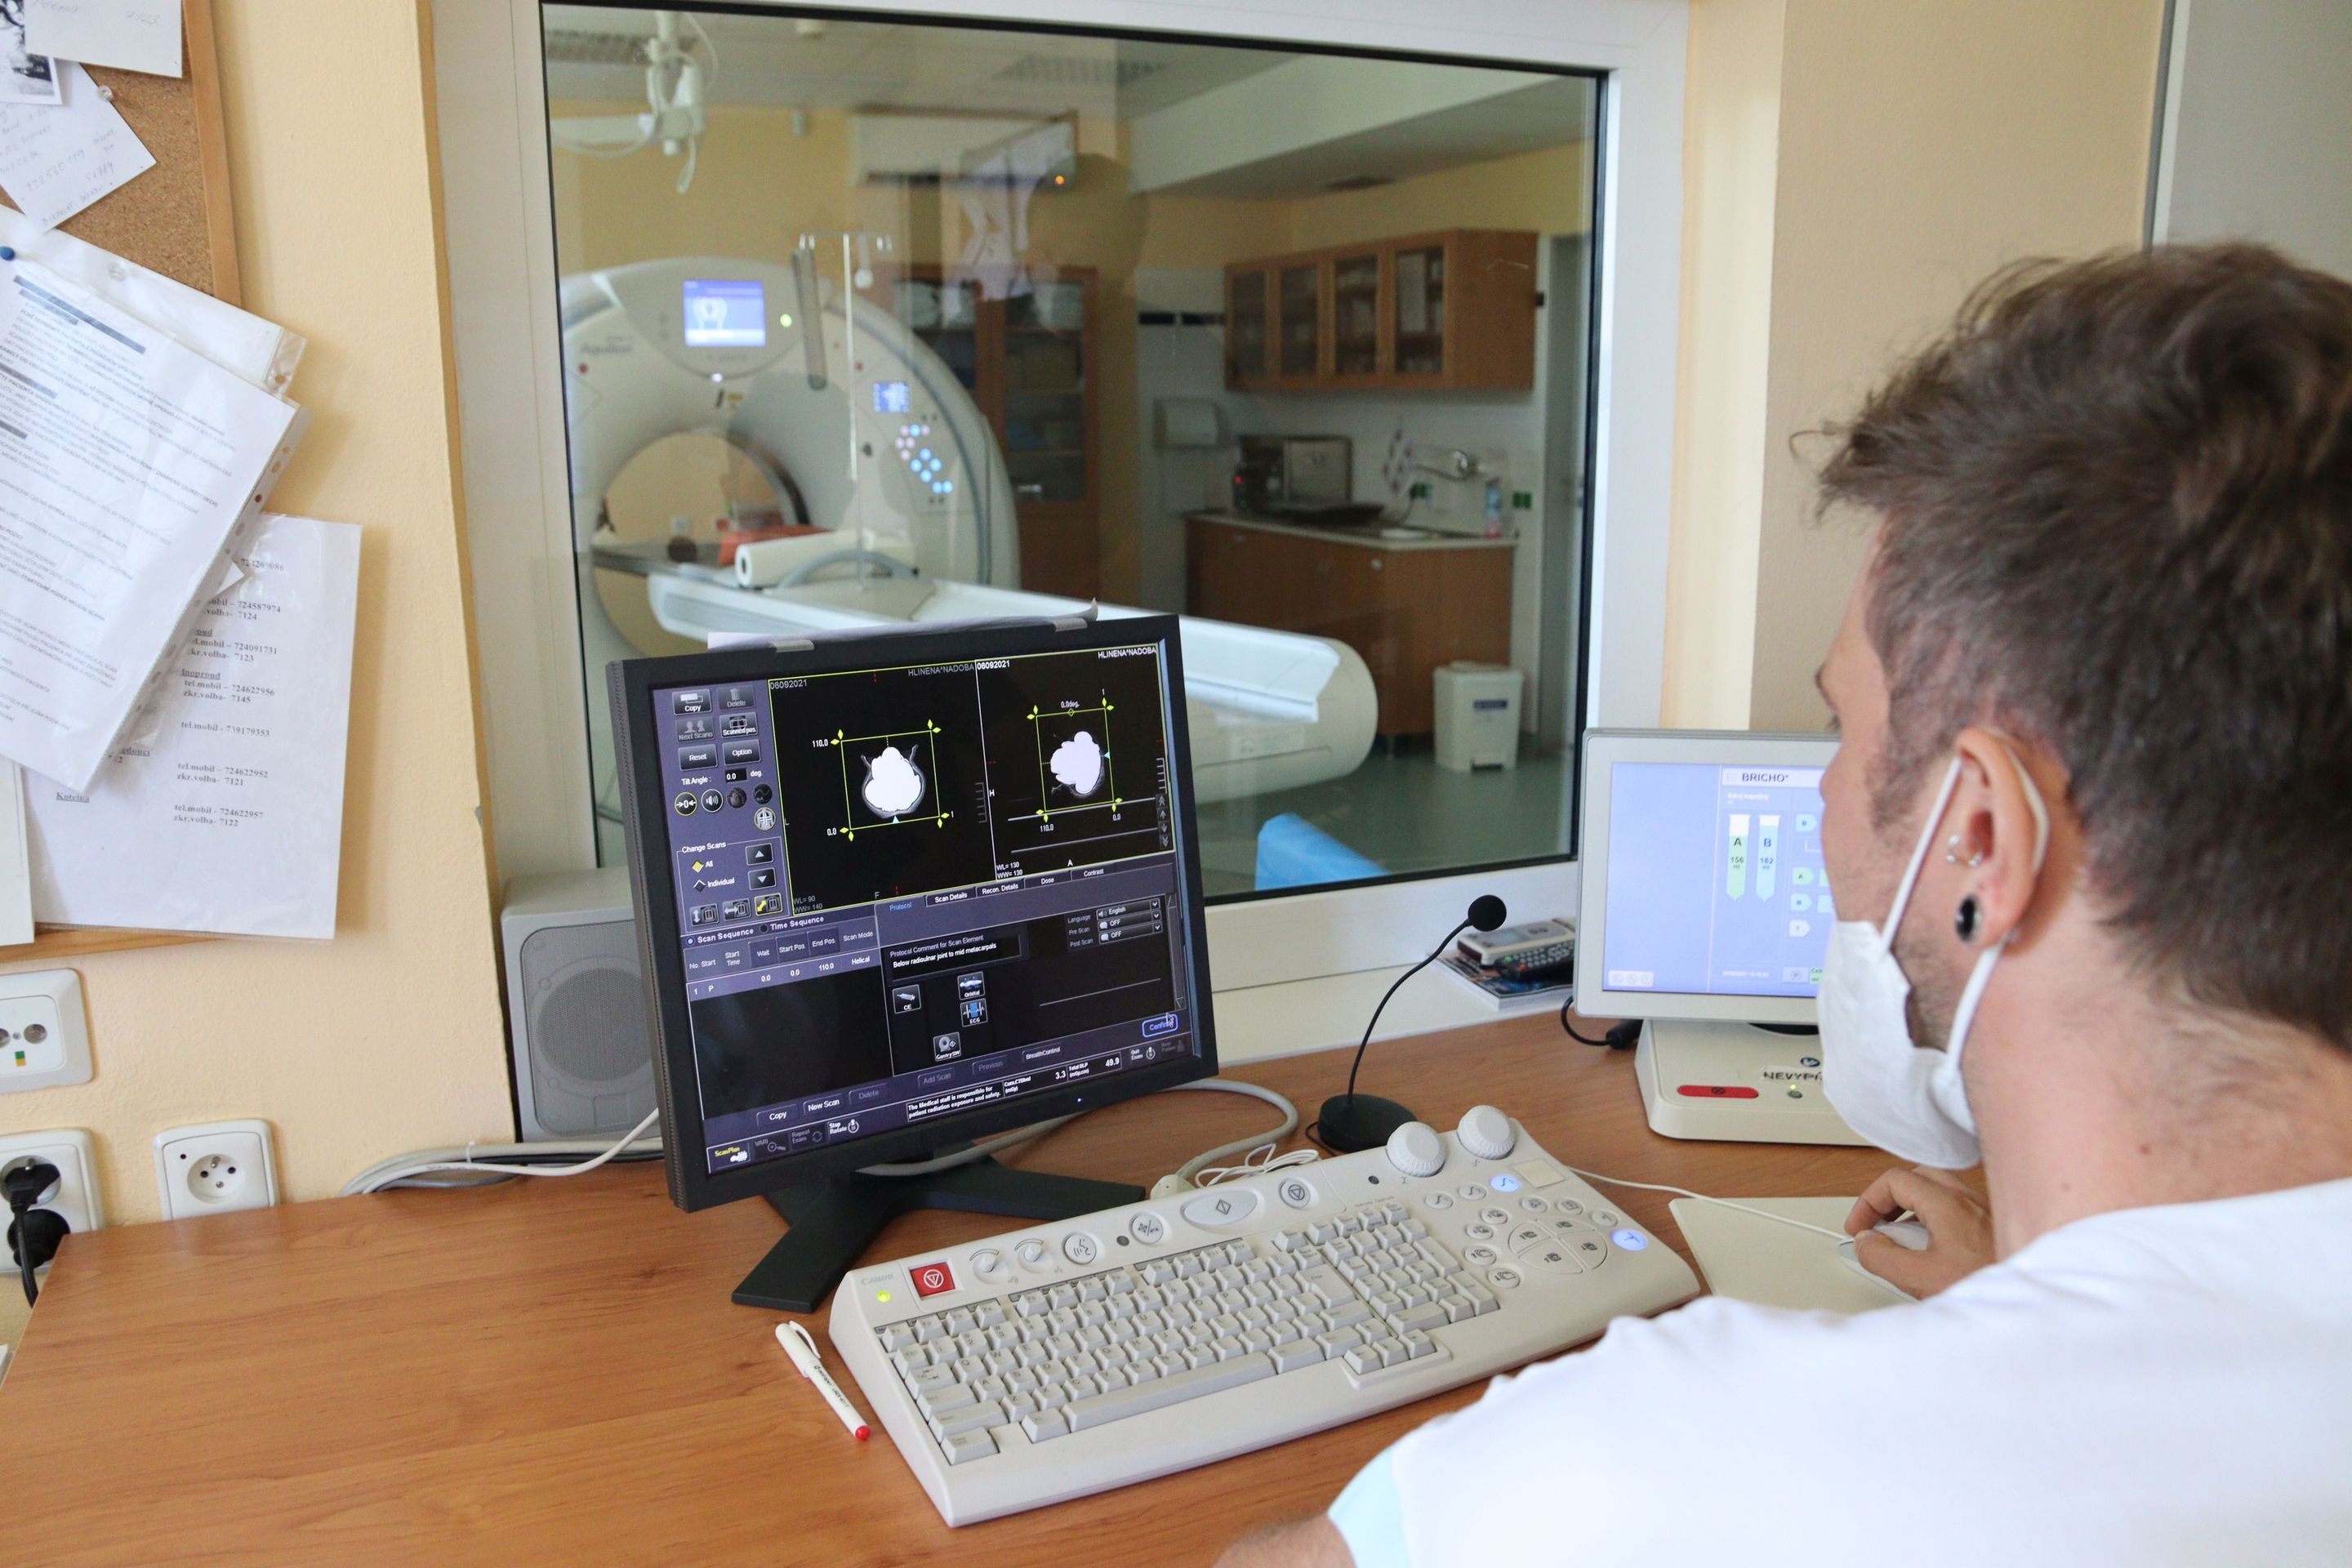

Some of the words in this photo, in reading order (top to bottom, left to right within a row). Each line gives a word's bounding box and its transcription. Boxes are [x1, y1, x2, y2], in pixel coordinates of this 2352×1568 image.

[812, 738, 829, 749] 110.0
[688, 753, 707, 761] Reset
[732, 748, 752, 757] Option
[826, 827, 837, 836] 0.0
[1733, 837, 1742, 847] A
[1764, 838, 1771, 848] B
[681, 844, 706, 854] Change
[706, 842, 726, 850] Scans
[705, 860, 714, 868] All
[1083, 868, 1104, 877] Contrast
[707, 877, 735, 888] Individual
[1001, 883, 1019, 892] Details
[934, 894, 949, 903] Scan
[949, 892, 968, 901] Details
[889, 902, 912, 911] Protocol
[1108, 906, 1126, 915] English
[770, 922, 788, 931] Time
[790, 915, 825, 928] Sequence
[1067, 914, 1091, 924] Language
[1109, 919, 1120, 927] OFF
[697, 933, 716, 944] Scan
[717, 928, 755, 941] Sequence
[843, 933, 858, 942] Scan
[858, 929, 874, 939] Mode
[812, 938, 823, 947] End
[823, 937, 835, 946] Pos
[890, 948, 912, 957] Protocol
[913, 943, 939, 954] Comment
[948, 938, 962, 947] Scan
[963, 934, 984, 944] Element
[1070, 940, 1080, 948] Post
[1081, 938, 1094, 946] Scan
[756, 949, 770, 957] Wait
[778, 945, 794, 954] Start
[794, 943, 805, 951] Pos
[724, 950, 740, 959] Start
[893, 959, 910, 969] Below
[937, 951, 948, 960] joint
[965, 942, 997, 954] metacarpals
[701, 959, 716, 968] Start
[727, 958, 741, 966] Time
[851, 956, 871, 965] Helical
[818, 962, 835, 972] 110.0
[761, 974, 771, 982] 0.0
[790, 969, 800, 977] 0.0
[978, 1061, 1004, 1071] Previous
[1105, 1057, 1120, 1067] 49.9
[923, 1076, 936, 1085] Add
[936, 1072, 951, 1082] Scan
[1055, 1070, 1067, 1080] 3.3
[858, 1089, 880, 1100] Delete
[919, 1098, 939, 1109] Medical
[956, 1088, 985, 1100] responsible
[808, 1102, 822, 1112] New
[823, 1098, 840, 1109] Scan
[908, 1108, 927, 1120] patient
[928, 1103, 951, 1114] radiation
[951, 1097, 974, 1108] exposure
[769, 1111, 787, 1121] Copy
[829, 1122, 841, 1130] Stop
[830, 1126, 848, 1135] Rotate
[715, 1146, 741, 1157] ScanPlan
